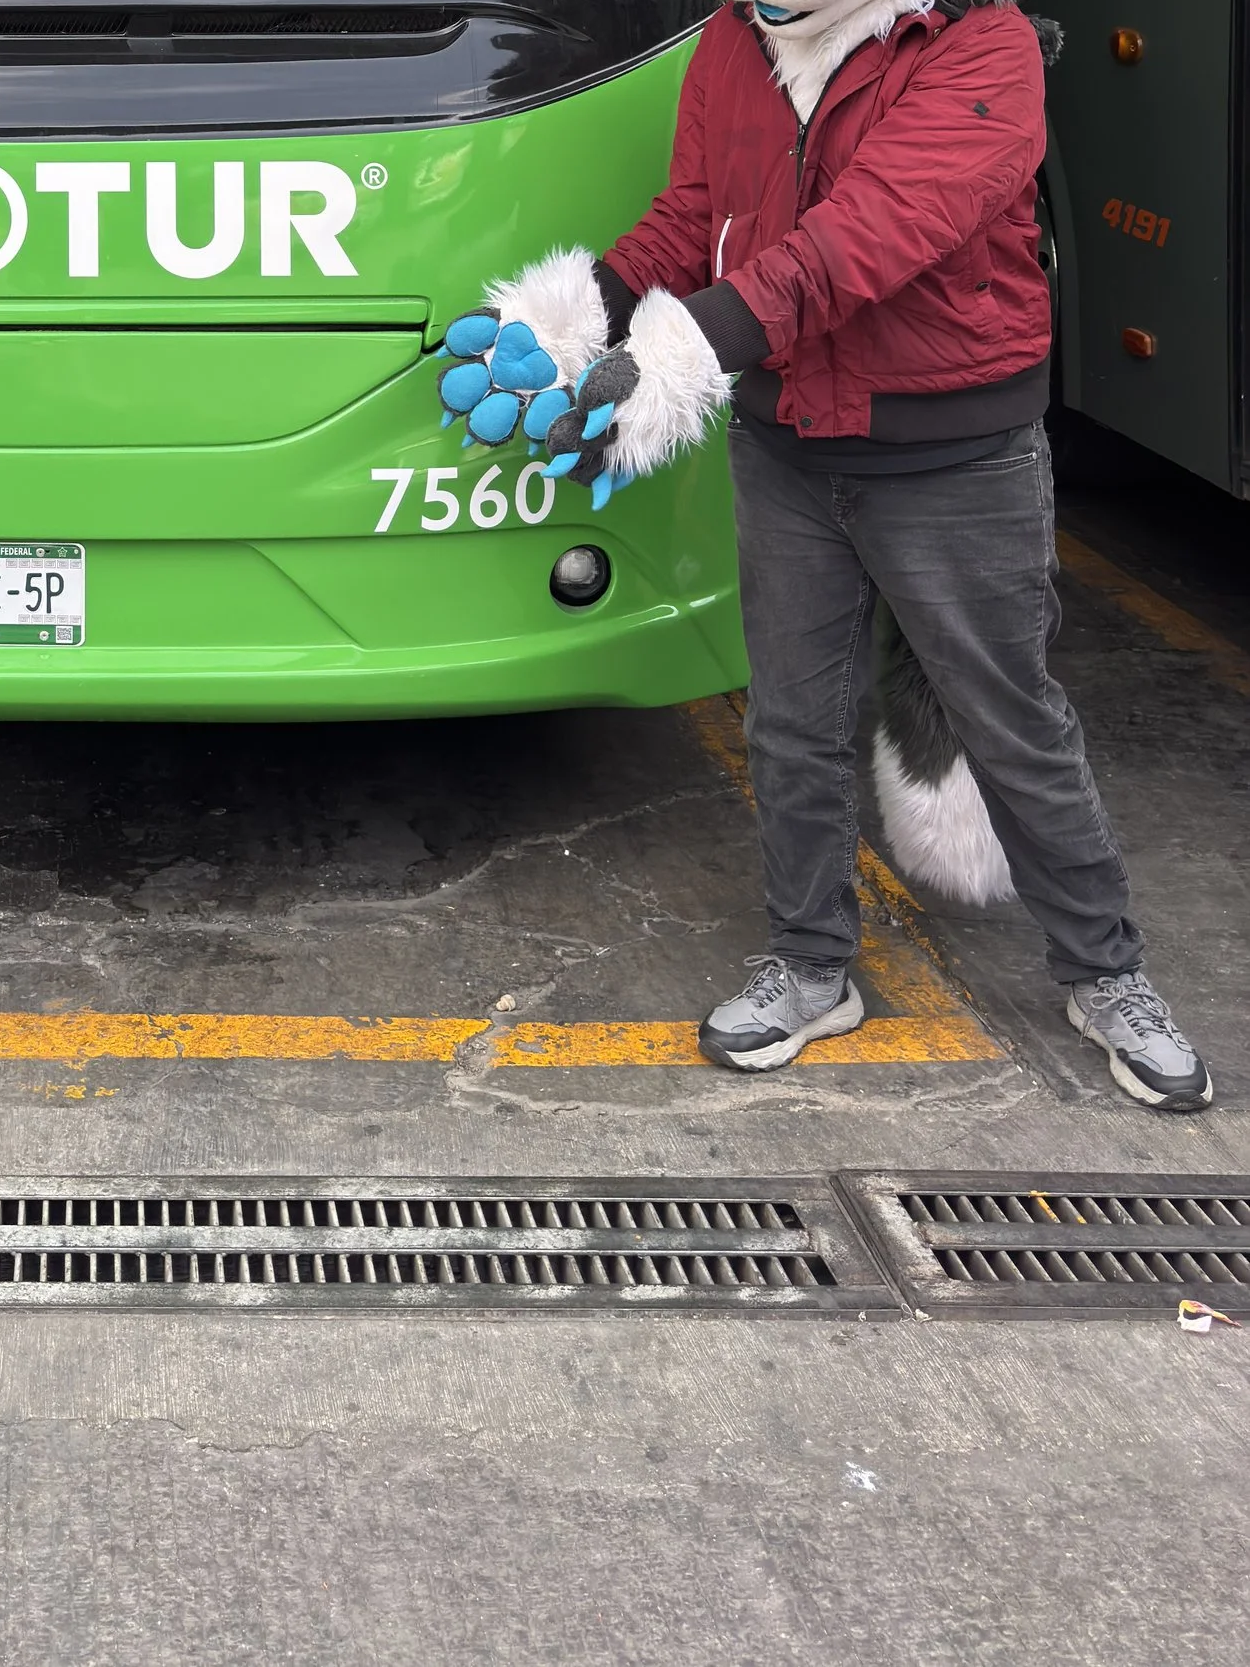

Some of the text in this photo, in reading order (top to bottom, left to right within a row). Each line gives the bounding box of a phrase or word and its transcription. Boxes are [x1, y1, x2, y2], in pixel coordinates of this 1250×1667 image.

[1101, 197, 1172, 248] 4191
[370, 461, 556, 533] 7560
[0, 546, 33, 557] FEDERAL
